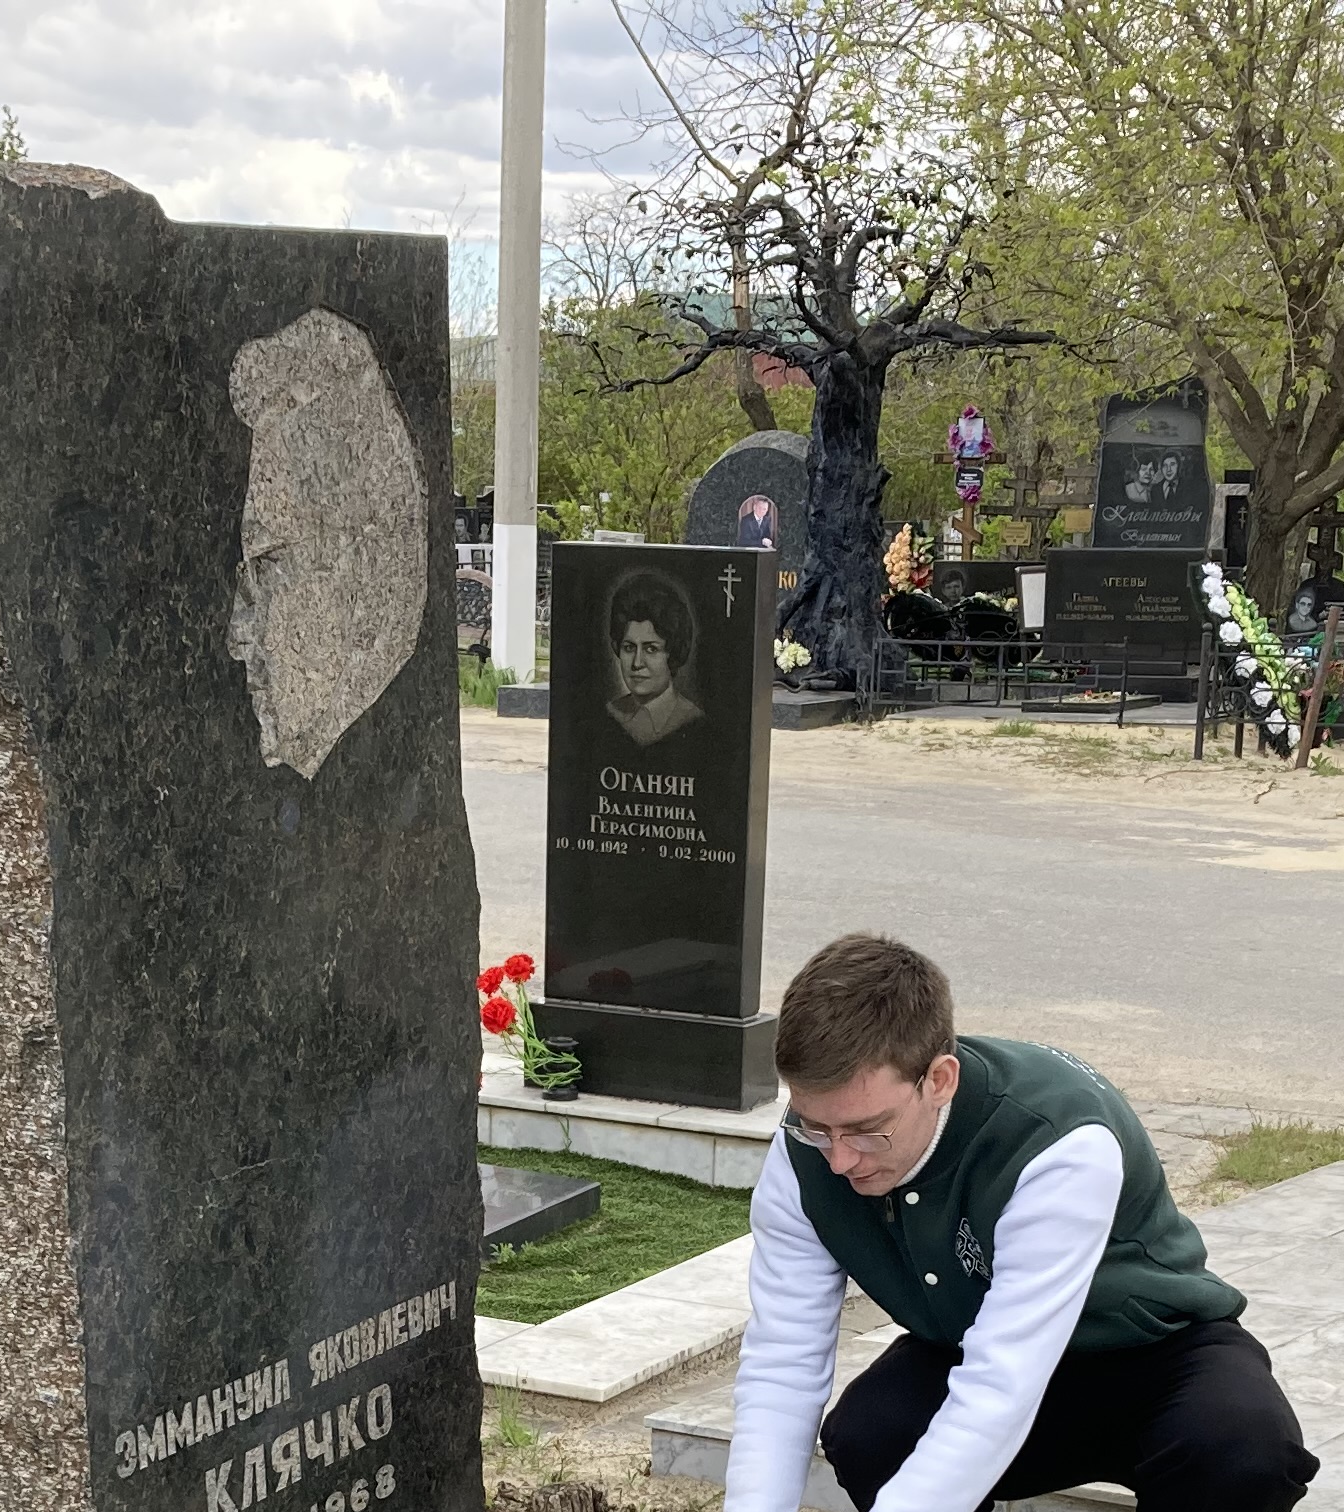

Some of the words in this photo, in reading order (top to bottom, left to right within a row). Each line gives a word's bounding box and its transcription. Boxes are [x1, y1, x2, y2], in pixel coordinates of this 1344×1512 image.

[1102, 577, 1148, 588] АГЕЕВЫ
[115, 1358, 292, 1480] ЭММАНУИЛ
[308, 1281, 457, 1388] ЯКОВЛЕВИЧ
